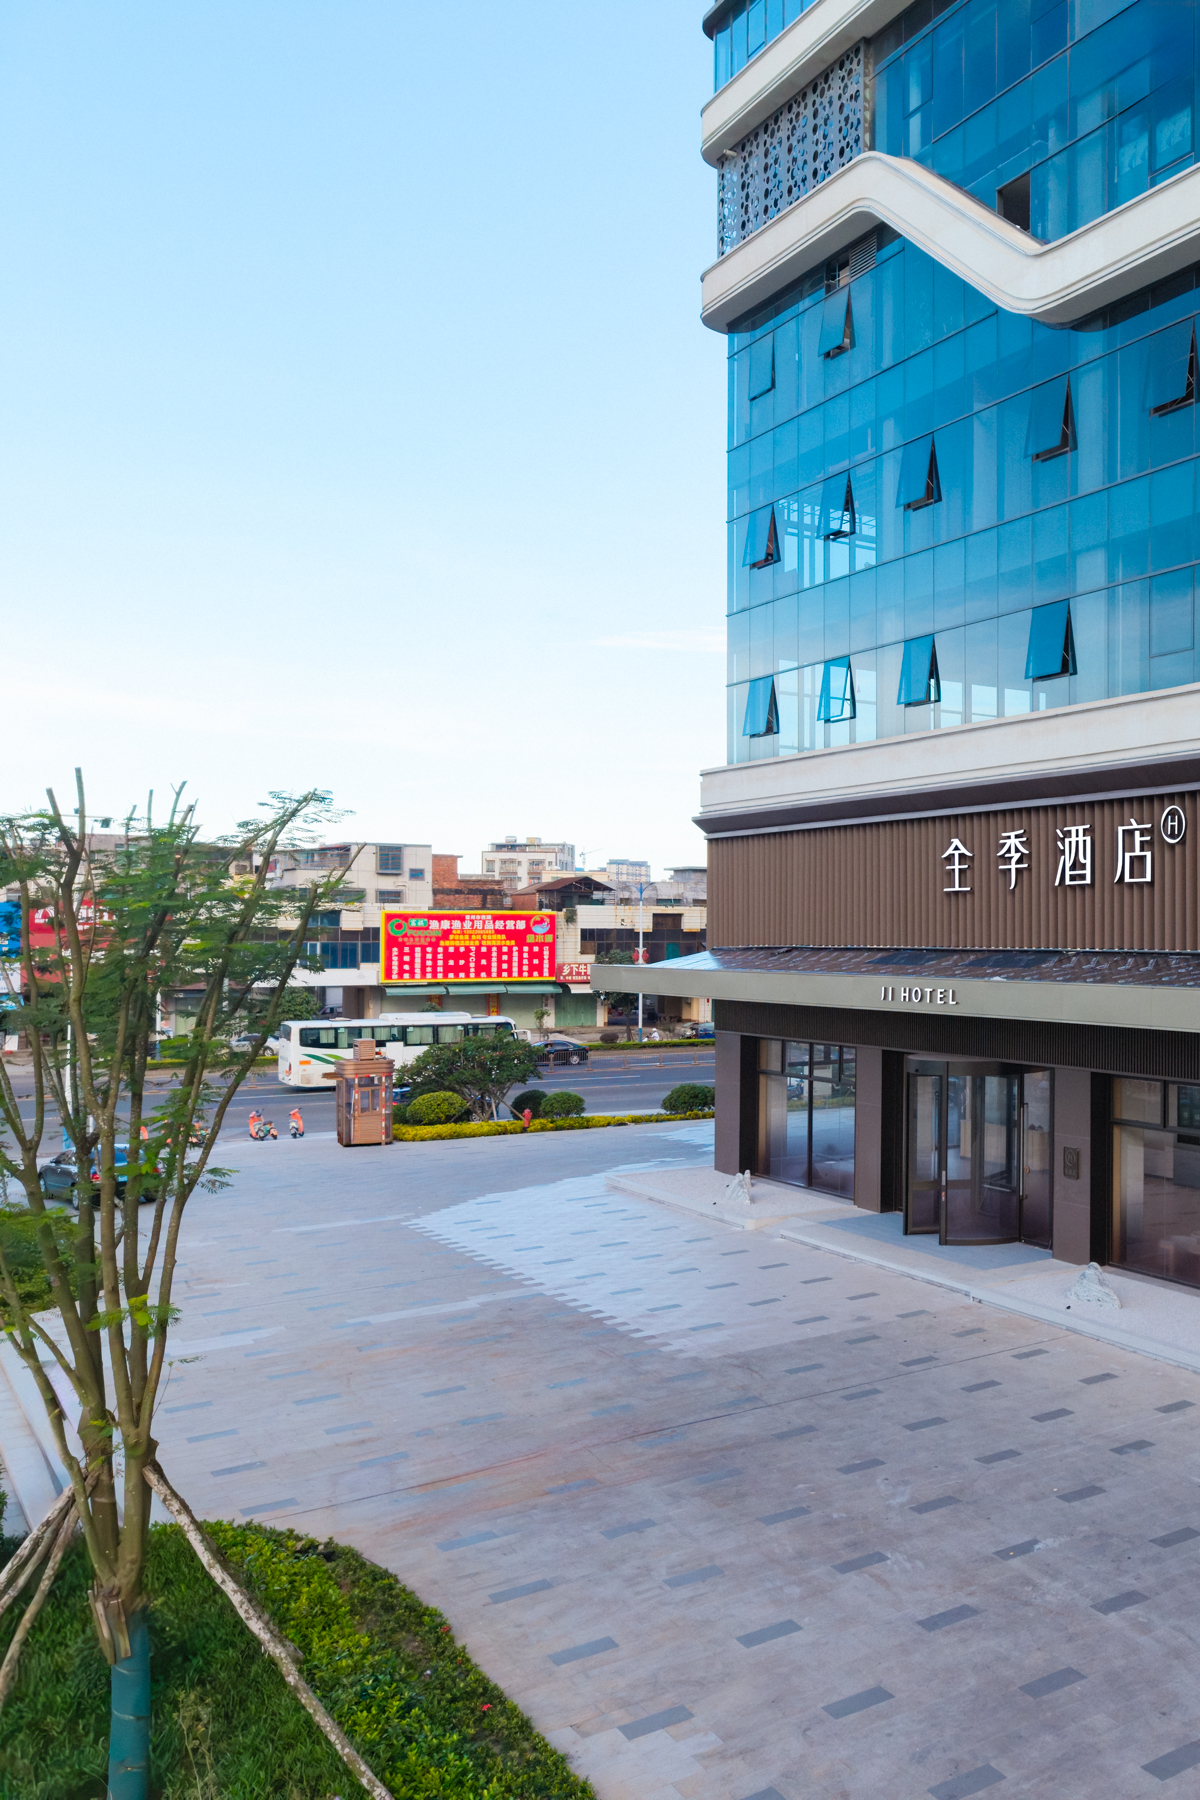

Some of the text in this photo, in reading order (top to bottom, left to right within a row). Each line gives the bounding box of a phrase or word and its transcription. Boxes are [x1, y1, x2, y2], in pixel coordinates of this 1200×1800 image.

[941, 818, 1153, 892] 全季酒店
[429, 920, 526, 929] 渔康渔业用品经营部
[901, 987, 958, 1005] HOTEL
